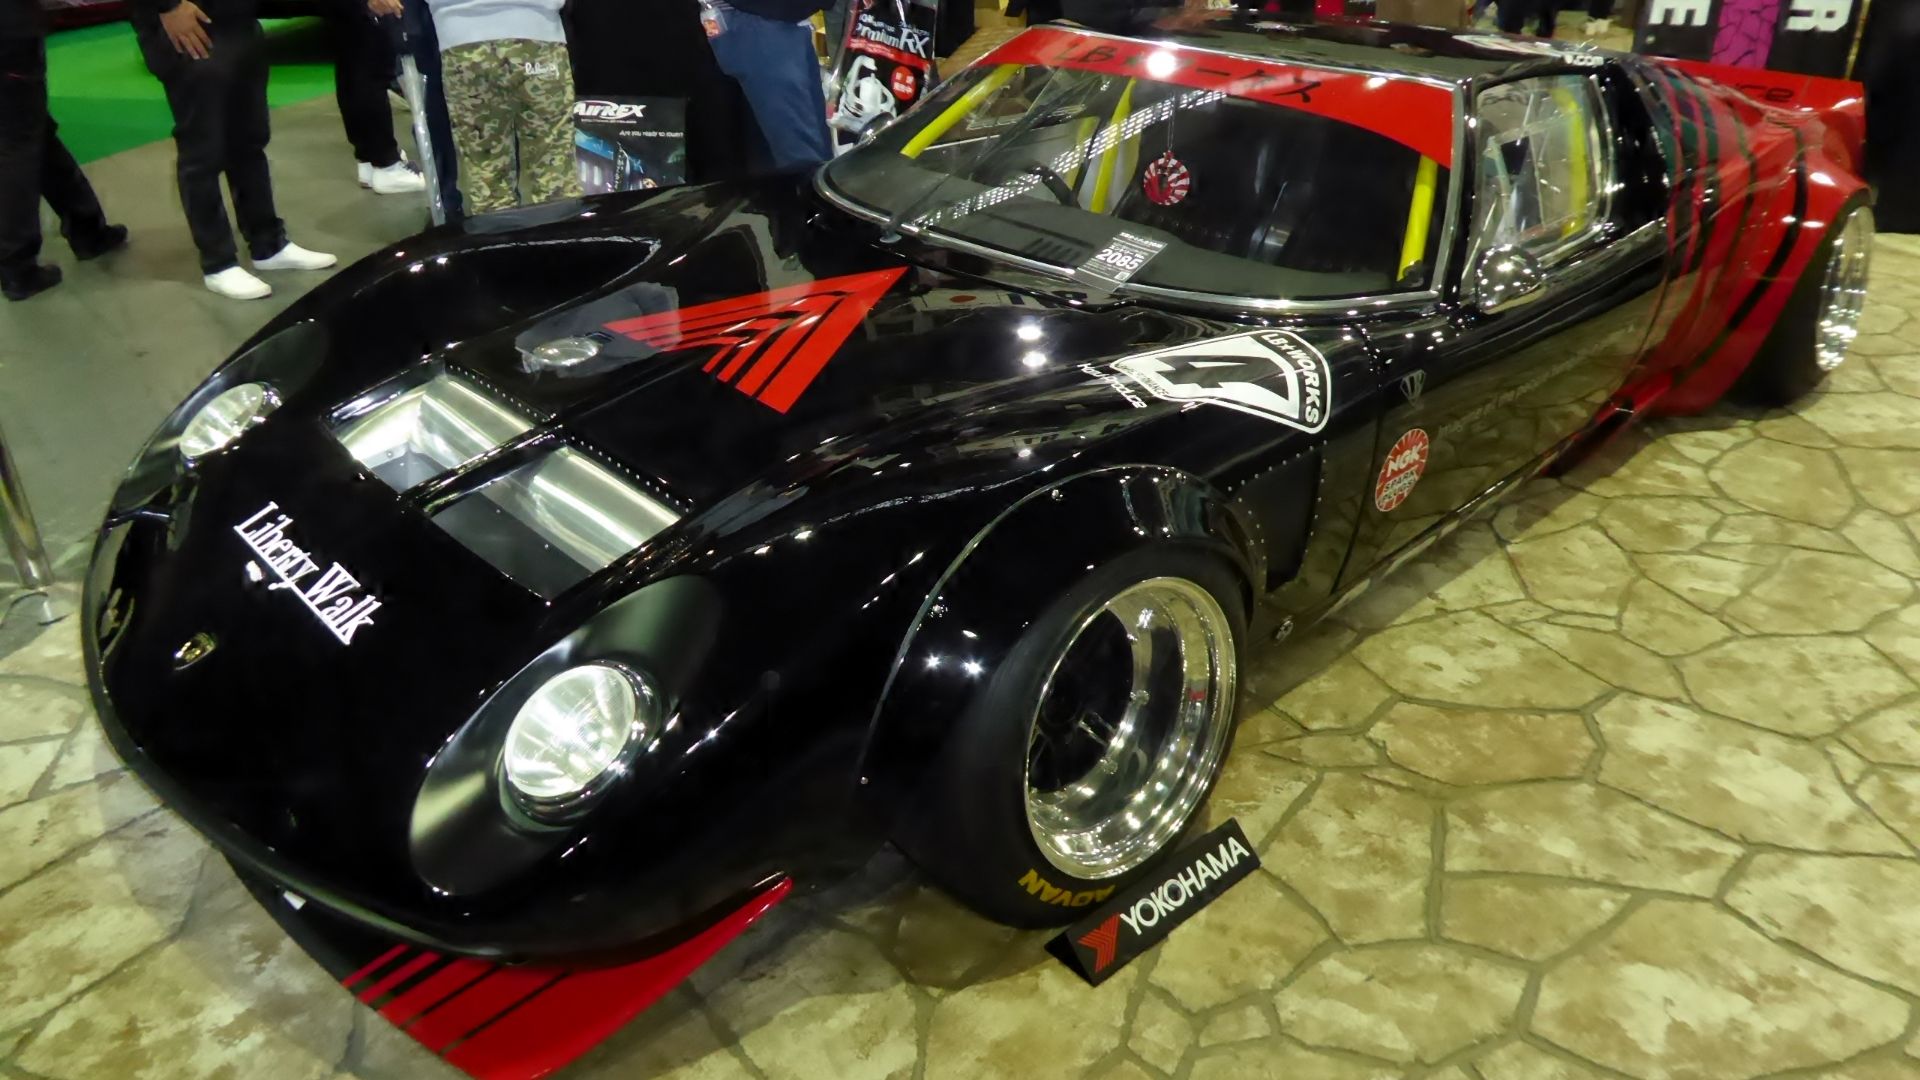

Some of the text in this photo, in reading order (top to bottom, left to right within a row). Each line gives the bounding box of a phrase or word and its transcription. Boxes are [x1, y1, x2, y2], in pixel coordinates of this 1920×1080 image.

[1095, 248, 1144, 271] 2085
[1386, 442, 1423, 478] NGK
[233, 501, 383, 646] Liberty Walk
[1017, 868, 1116, 908] ADVAN
[1119, 836, 1250, 936] YOKOHAMA
